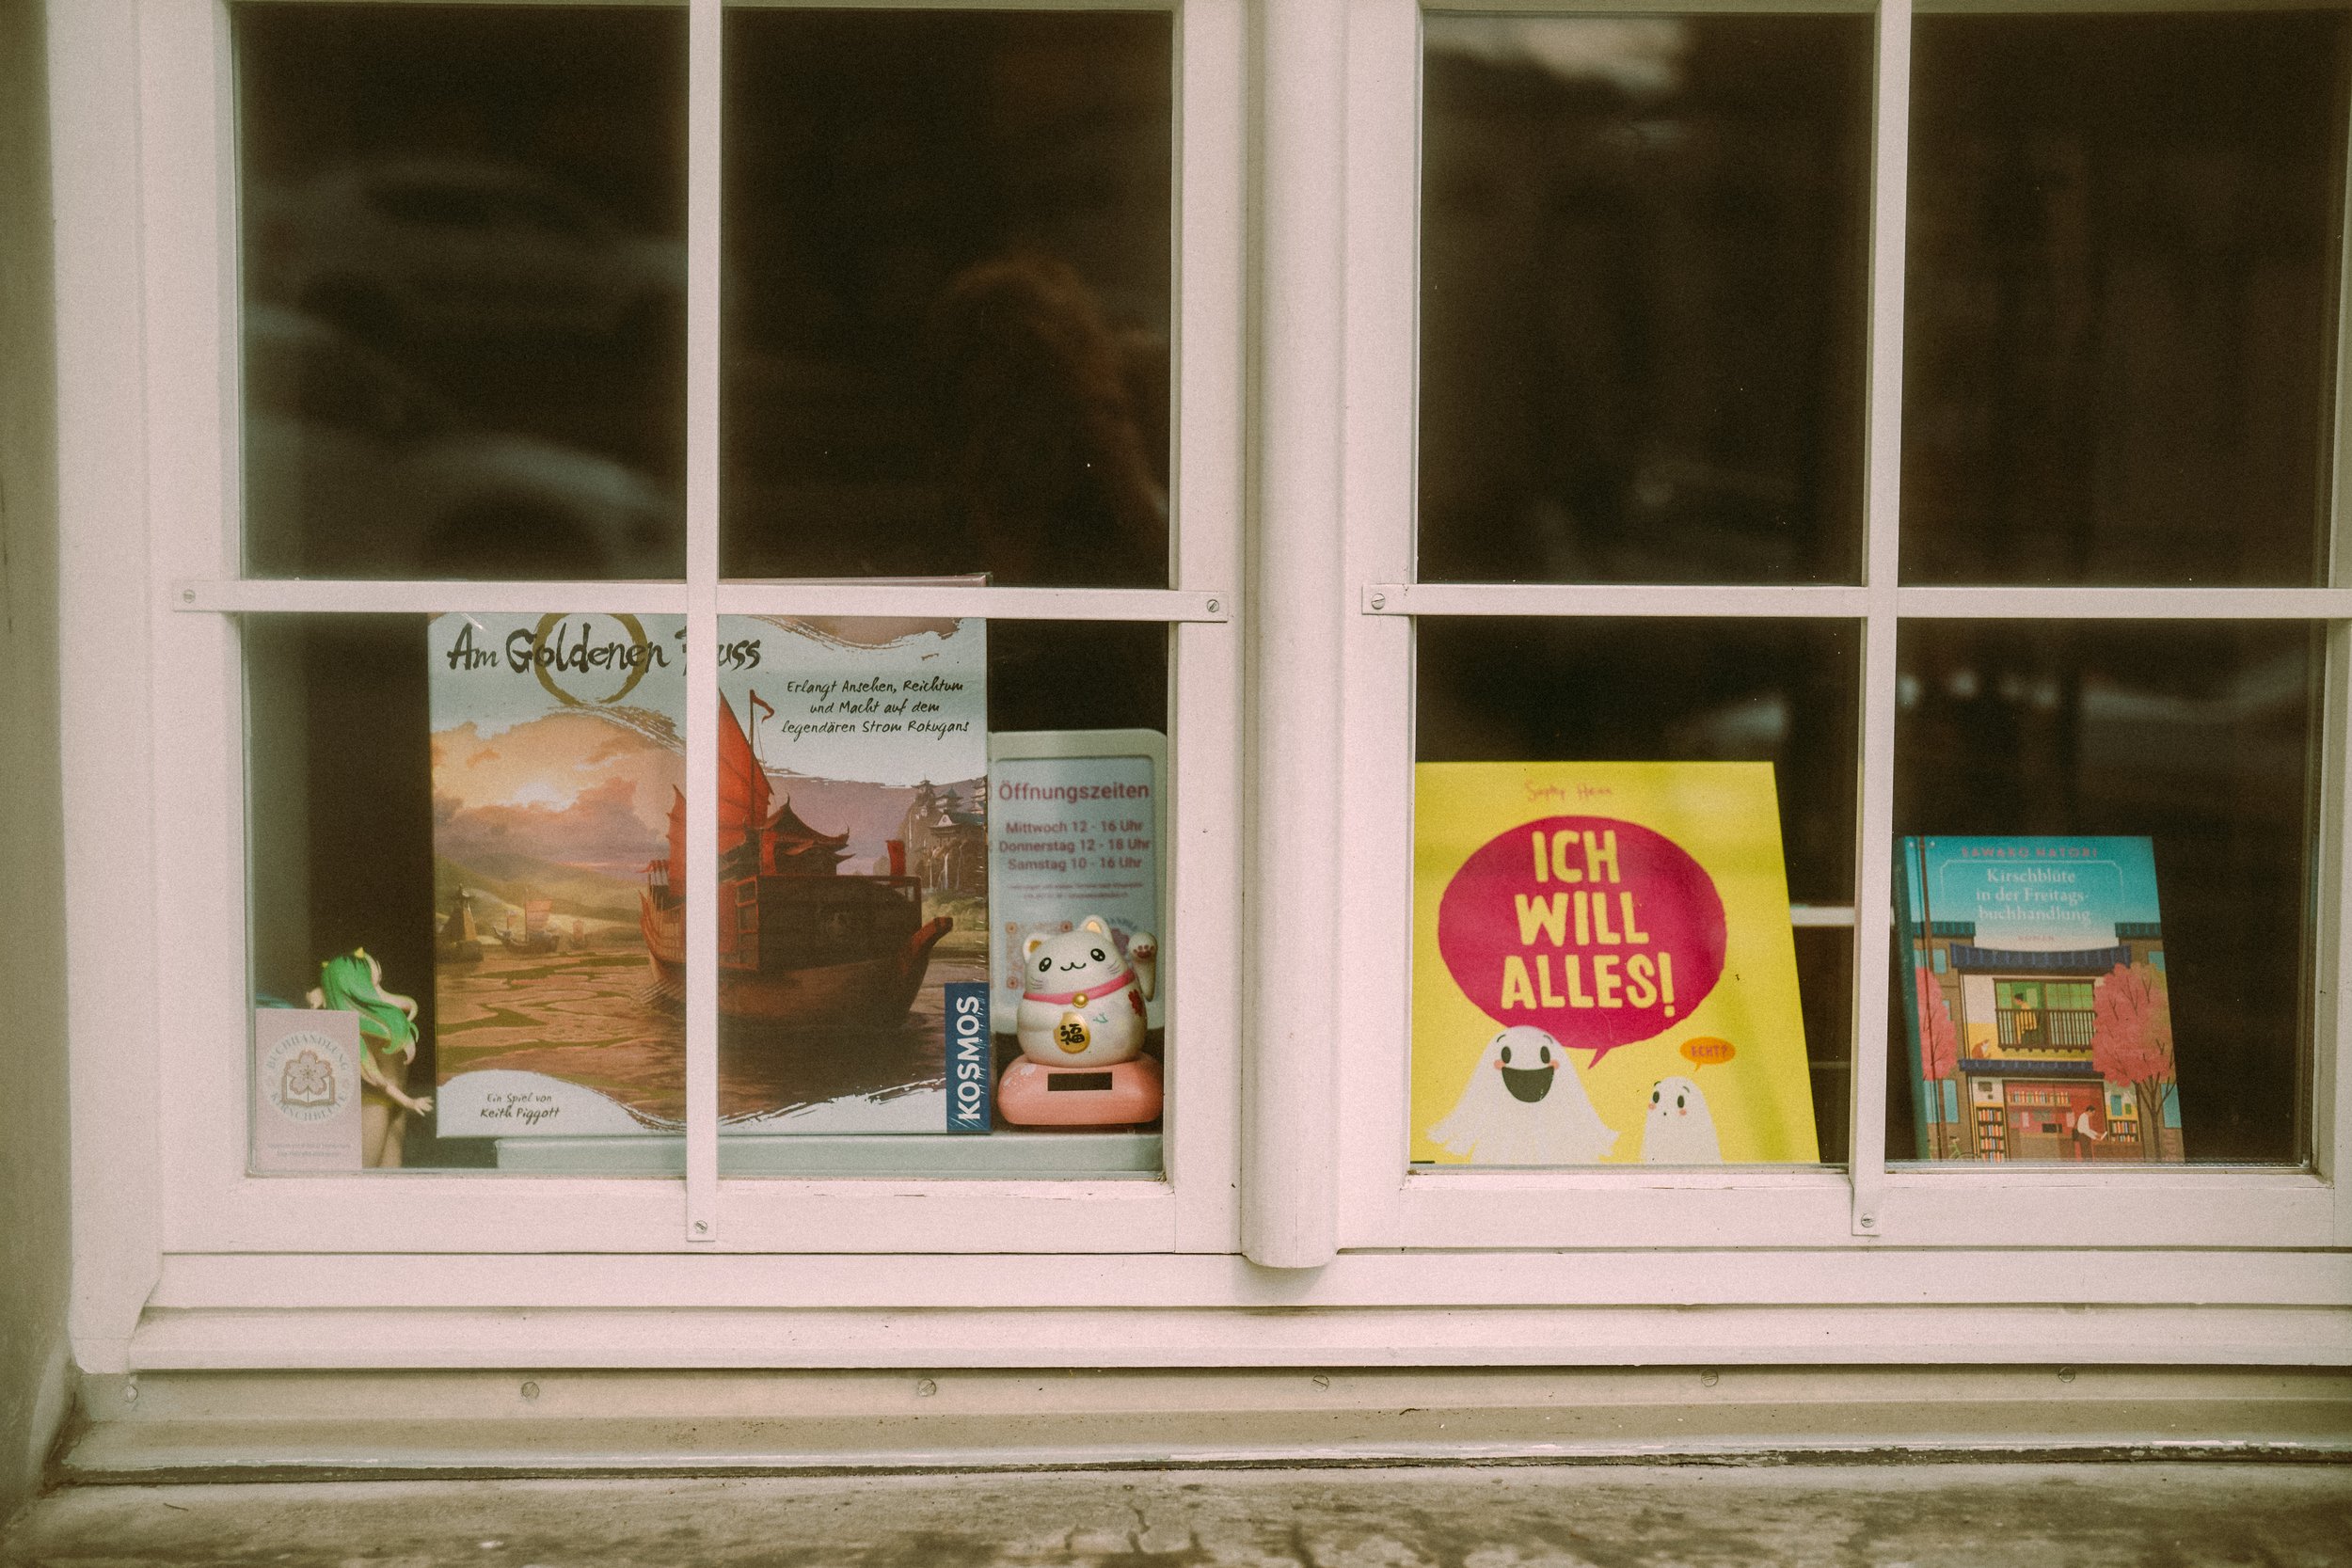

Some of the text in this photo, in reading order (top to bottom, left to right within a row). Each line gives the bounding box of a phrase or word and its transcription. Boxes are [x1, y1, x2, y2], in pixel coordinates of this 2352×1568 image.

[447, 622, 762, 676] Am Goldenen uss
[787, 675, 964, 702] Erlangt Ansehen, Reichtum
[810, 697, 940, 716] und Macht auf dem
[781, 720, 970, 743] legendären Strom Rokugans
[998, 780, 1151, 804] Öffnungszeiten
[1005, 821, 1069, 834] Mittwoch
[1072, 820, 1089, 833] 12
[1101, 819, 1118, 832] 16
[1120, 819, 1144, 832] Uhr
[998, 840, 1075, 854] Donnerstag
[1080, 838, 1096, 851] 12
[1127, 838, 1151, 850] Uhr
[1532, 830, 1621, 883] ICH
[1008, 858, 1067, 872] Samstag
[1071, 857, 1088, 870] 10
[1100, 857, 1116, 869] 16
[1119, 856, 1143, 869] Uhr
[1987, 867, 2076, 884] Kirschblüte
[1976, 886, 2089, 906] in der Freitags-
[1514, 891, 1649, 947] WILL
[1979, 905, 2092, 926] buchhandlung
[1501, 952, 1676, 1018] ALLES!
[955, 995, 981, 1121] KOSMOS
[486, 1093, 502, 1102] Ein
[507, 1092, 533, 1109] Spiel
[480, 1107, 560, 1126] Keith Piggott
